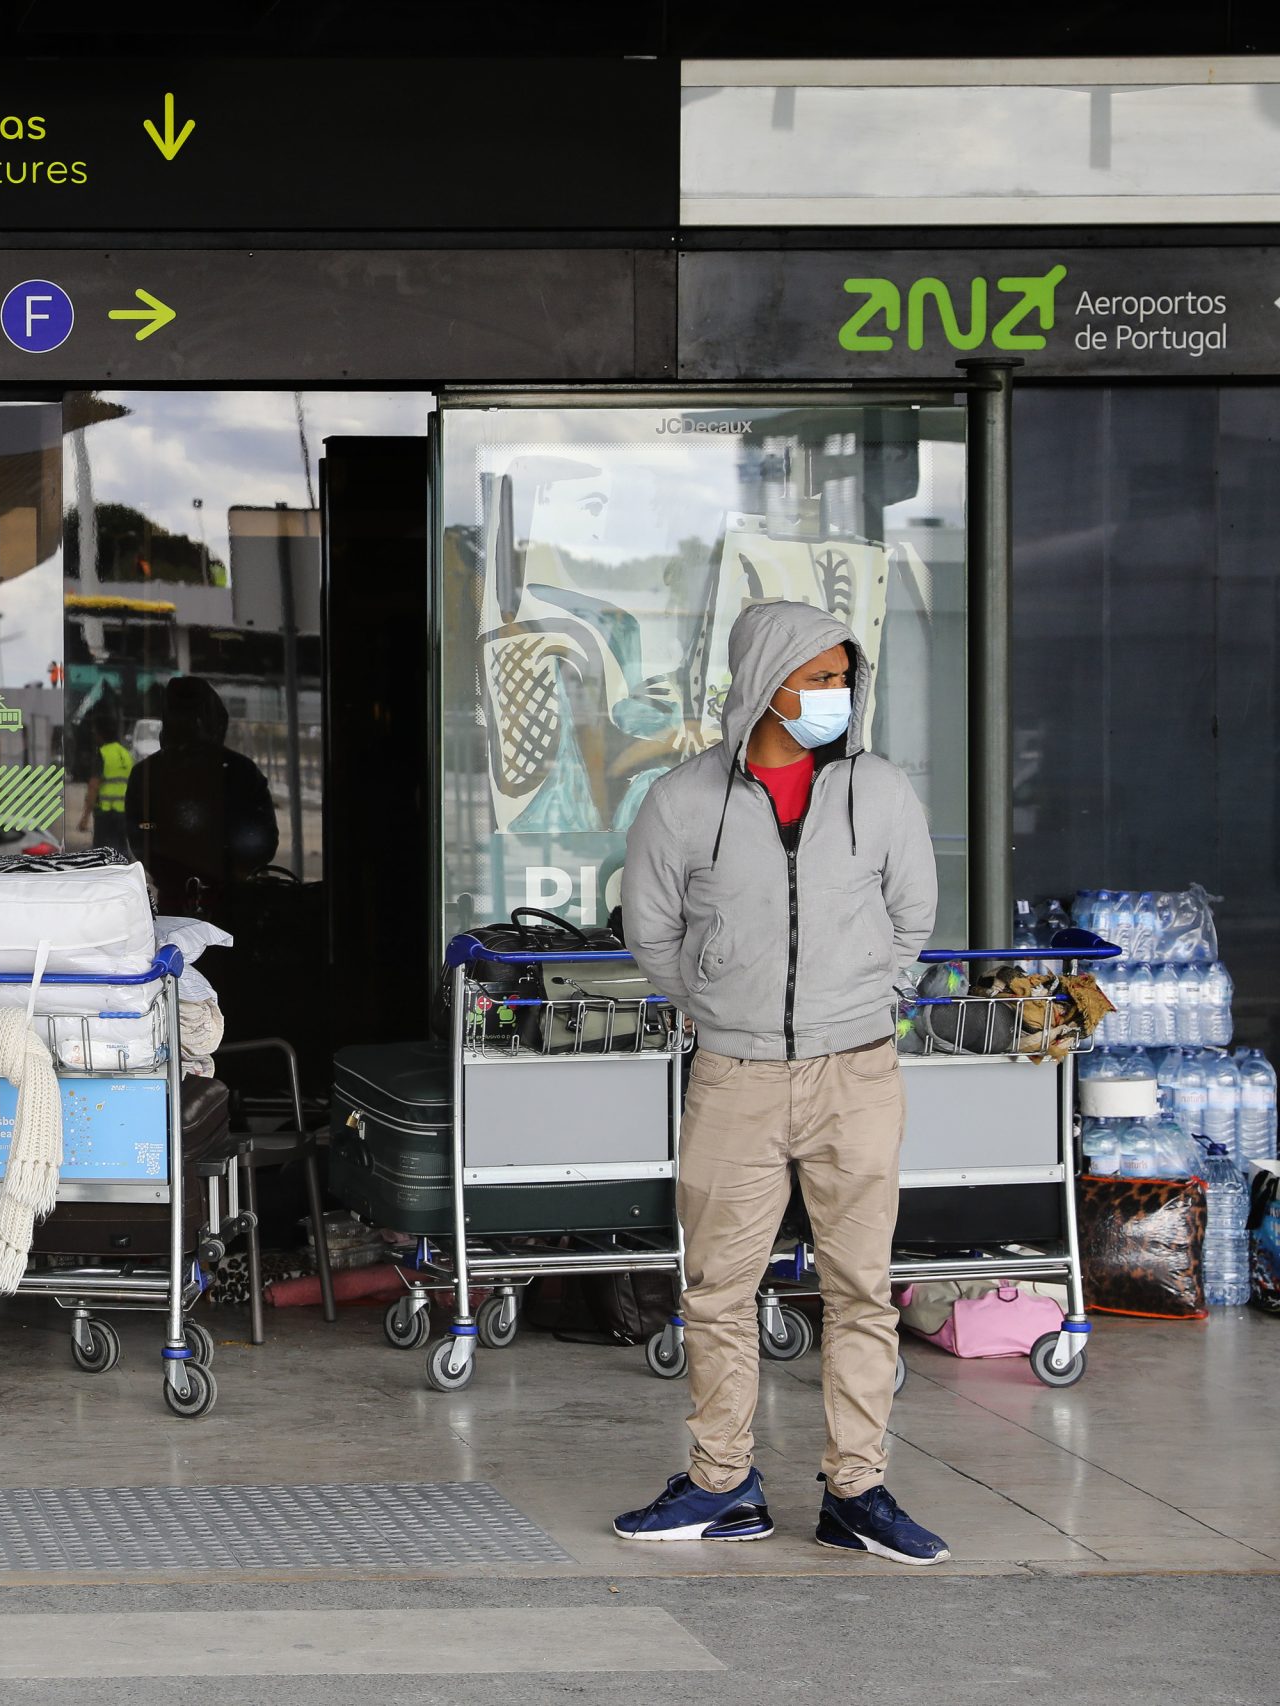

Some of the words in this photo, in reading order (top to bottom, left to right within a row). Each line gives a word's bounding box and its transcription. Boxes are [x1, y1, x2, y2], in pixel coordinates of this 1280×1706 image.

[26, 295, 53, 337] F
[1075, 290, 1226, 322] Aeroportos
[1075, 323, 1107, 351] de
[1116, 323, 1227, 357] Portugal
[655, 417, 753, 434] JCDecaux
